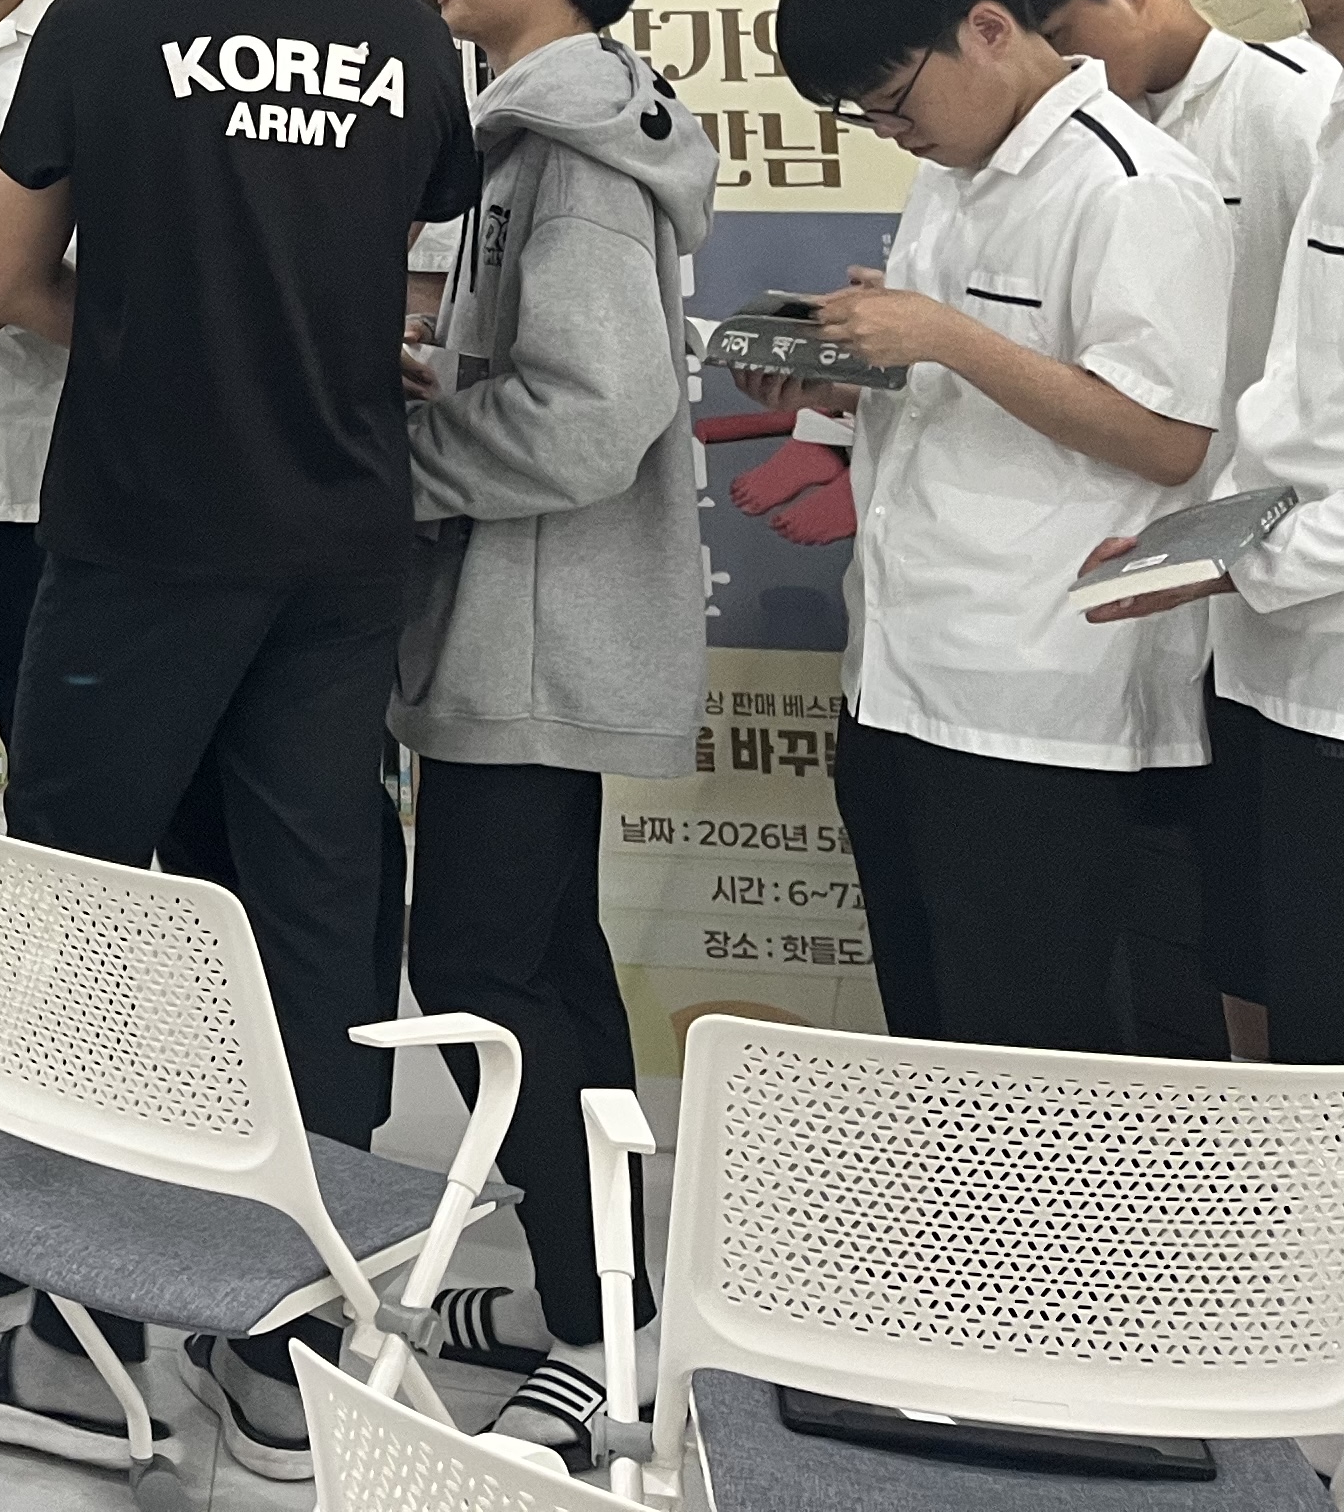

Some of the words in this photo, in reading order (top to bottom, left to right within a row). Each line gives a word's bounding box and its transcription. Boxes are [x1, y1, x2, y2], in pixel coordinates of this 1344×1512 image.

[161, 34, 404, 118] KOREA
[225, 101, 357, 149] ARMY
[732, 692, 776, 717] 판매
[731, 727, 836, 778] 바꾸
[621, 815, 675, 844] 날짜
[697, 820, 808, 852] 2026년
[712, 876, 765, 906] 시간
[704, 930, 759, 960] 장소
[781, 935, 873, 965] 핫들도
